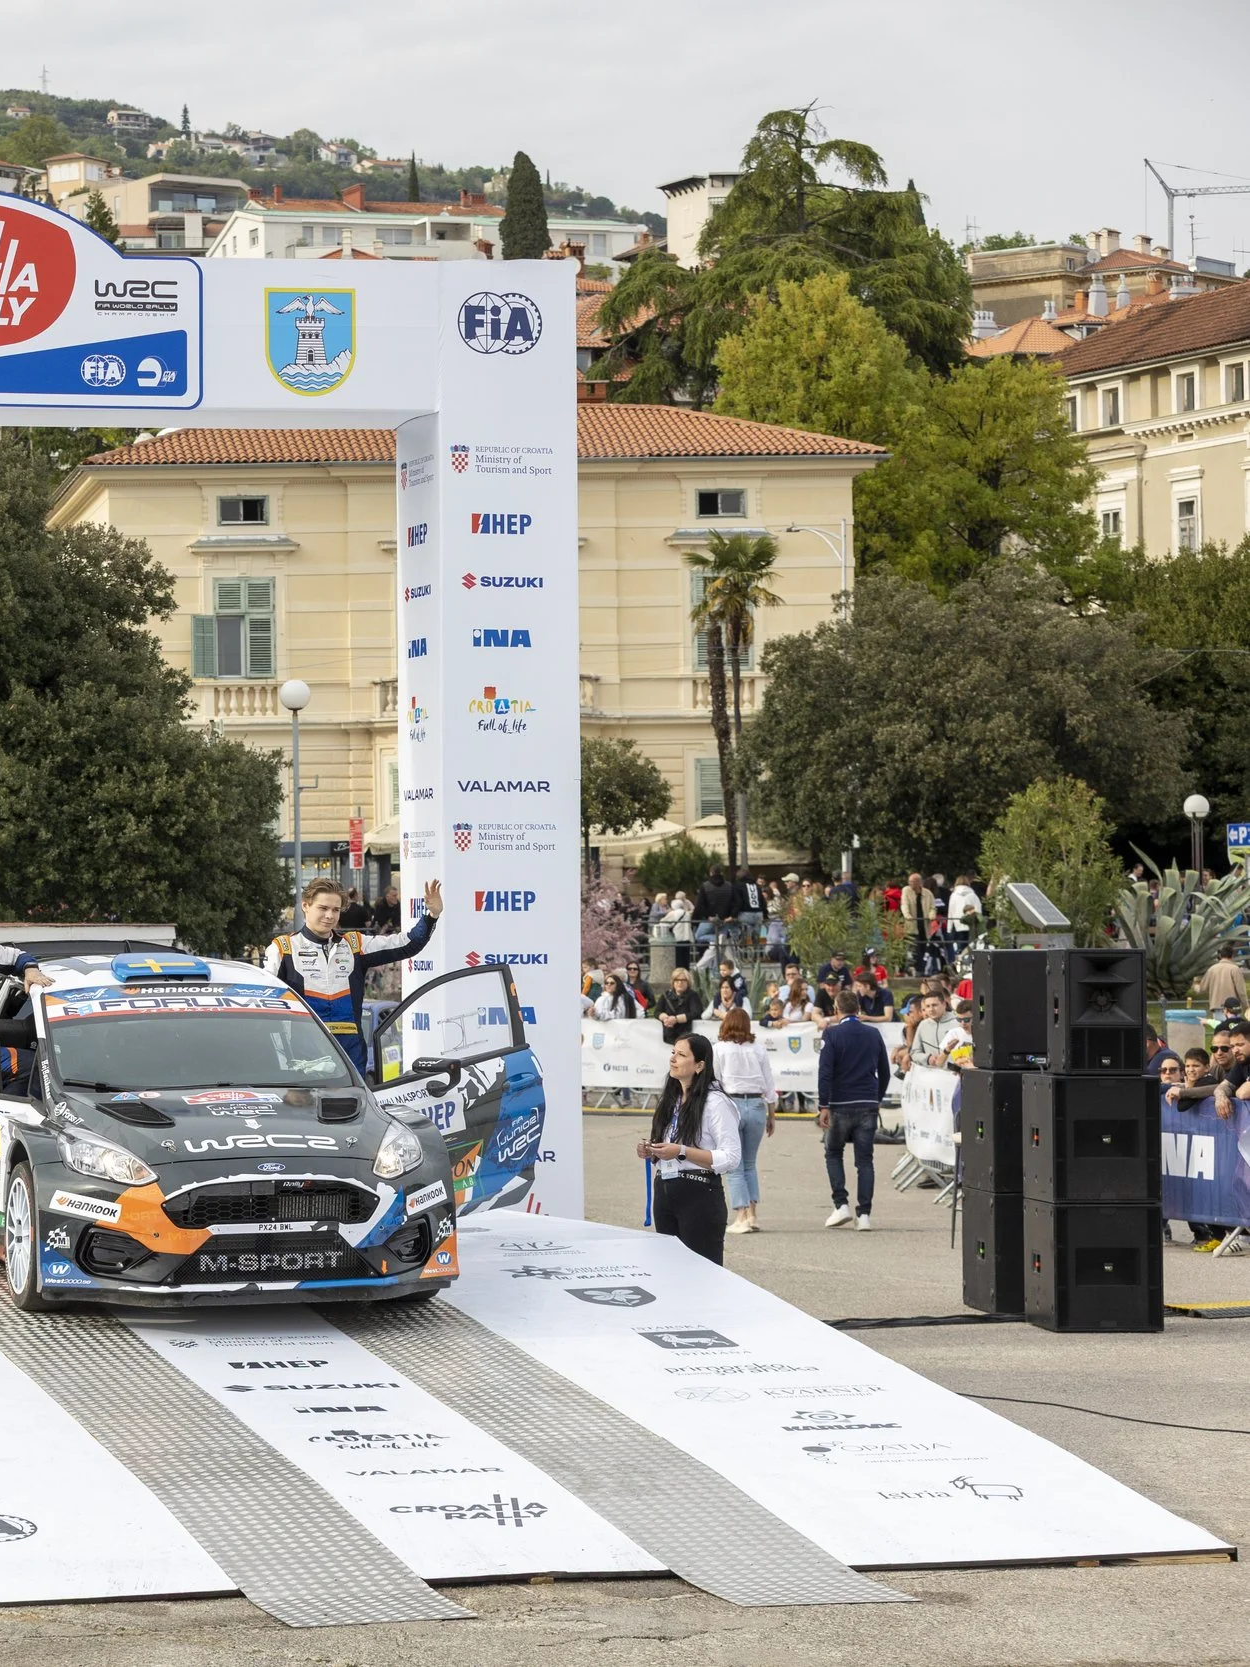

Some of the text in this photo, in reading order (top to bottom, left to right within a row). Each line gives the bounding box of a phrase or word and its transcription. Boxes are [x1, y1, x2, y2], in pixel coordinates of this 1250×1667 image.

[94, 279, 178, 299] WRC
[475, 446, 510, 454] REPUBLIC
[522, 447, 554, 455] CROATIA
[475, 455, 523, 465] Ministry of
[475, 464, 552, 476] Tourism and Sport
[493, 513, 532, 535] HEP
[414, 523, 428, 547] HEP
[480, 576, 543, 588] SUZUKI
[410, 584, 432, 599] SUZUKI
[468, 698, 536, 715] CROATIA
[478, 718, 527, 733] Full of life
[457, 780, 551, 793] VALAMAR
[403, 788, 434, 801] VALAMAR
[478, 823, 557, 831] REPUBLIC OF CROATIA
[478, 832, 525, 843] Ministry of
[1238, 826, 1248, 844] P
[478, 842, 556, 853] Tourism and Sport
[496, 891, 536, 912] HEP
[484, 953, 548, 965] SUZUKI
[414, 960, 434, 971] SUZUKI
[100, 996, 292, 1011] FORUM8
[500, 1115, 537, 1145] JUNIOR
[184, 1134, 339, 1153] WRC2
[498, 1124, 541, 1162] WRC
[279, 1223, 294, 1231] BWL
[200, 1251, 344, 1272] M-SPORT
[262, 1359, 329, 1369] HEP
[664, 1363, 785, 1374] primorsko
[716, 1365, 819, 1376] goranska
[263, 1382, 401, 1391] SUZUKI
[762, 1386, 890, 1397] KVARNER
[781, 1422, 903, 1432] KARLOVAC
[308, 1432, 452, 1443] CROATIA
[840, 1441, 953, 1452] OPATIJA
[346, 1466, 505, 1477] VALAMAR
[877, 1489, 955, 1501] Istria
[389, 1500, 549, 1514] CROATIA
[444, 1510, 550, 1521] RALLY
